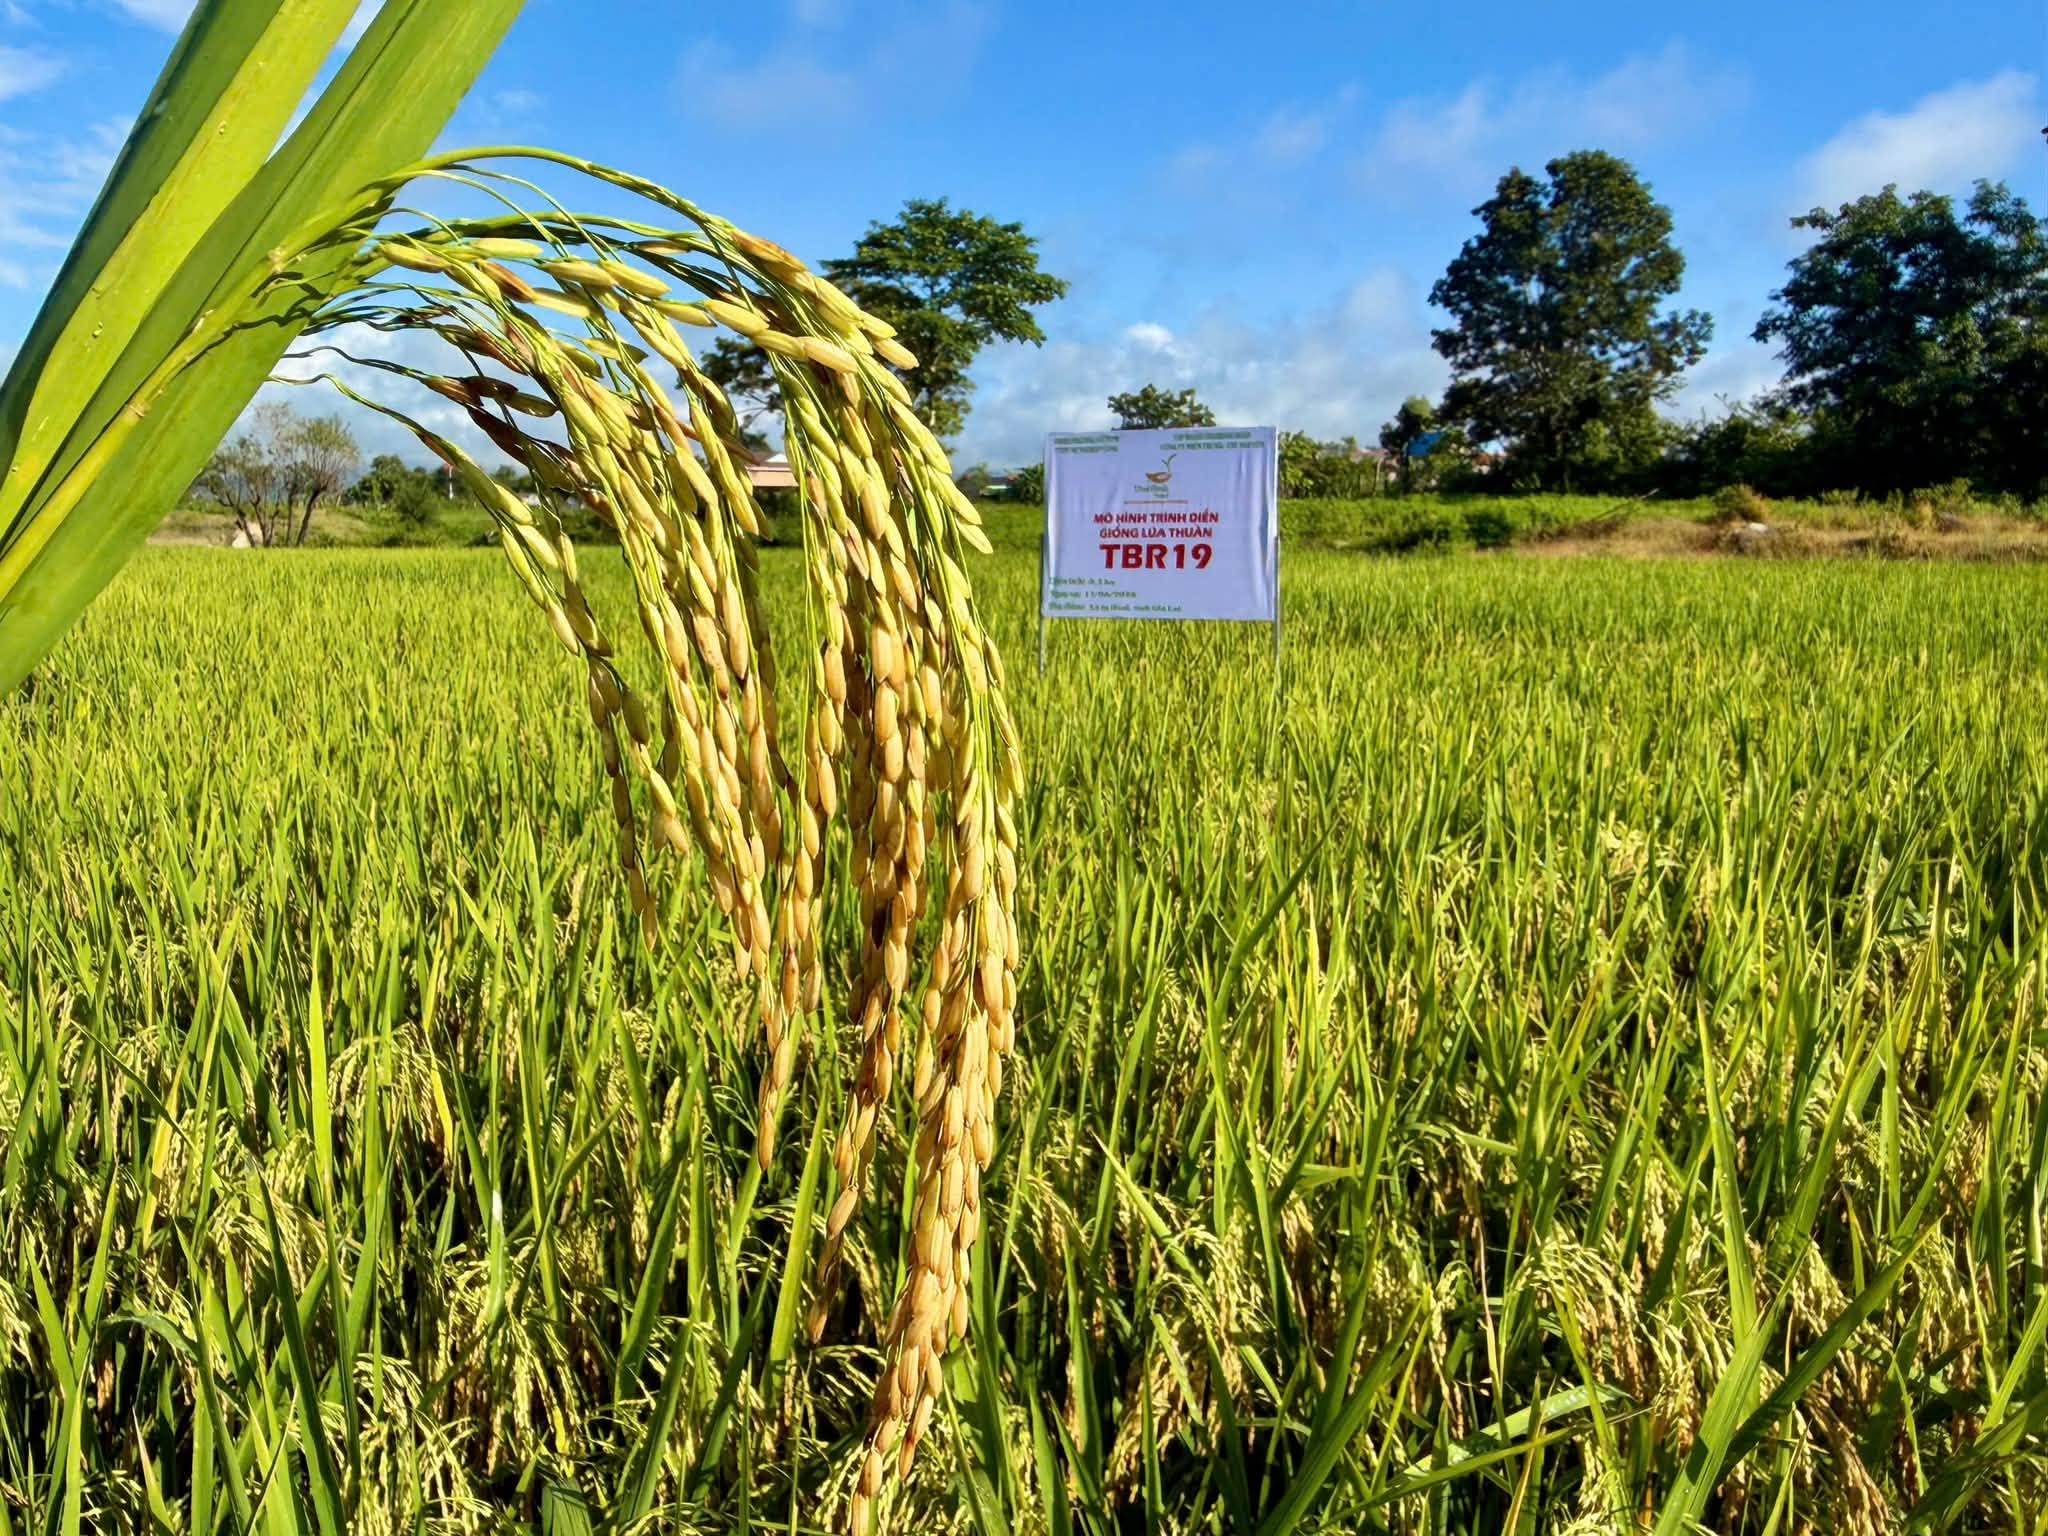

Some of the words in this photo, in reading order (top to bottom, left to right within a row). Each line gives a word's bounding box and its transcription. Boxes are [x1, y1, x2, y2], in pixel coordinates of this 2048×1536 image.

[1094, 511, 1113, 523] MÔ
[1116, 511, 1147, 523] HÌNH
[1099, 543, 1212, 569] TBR19
